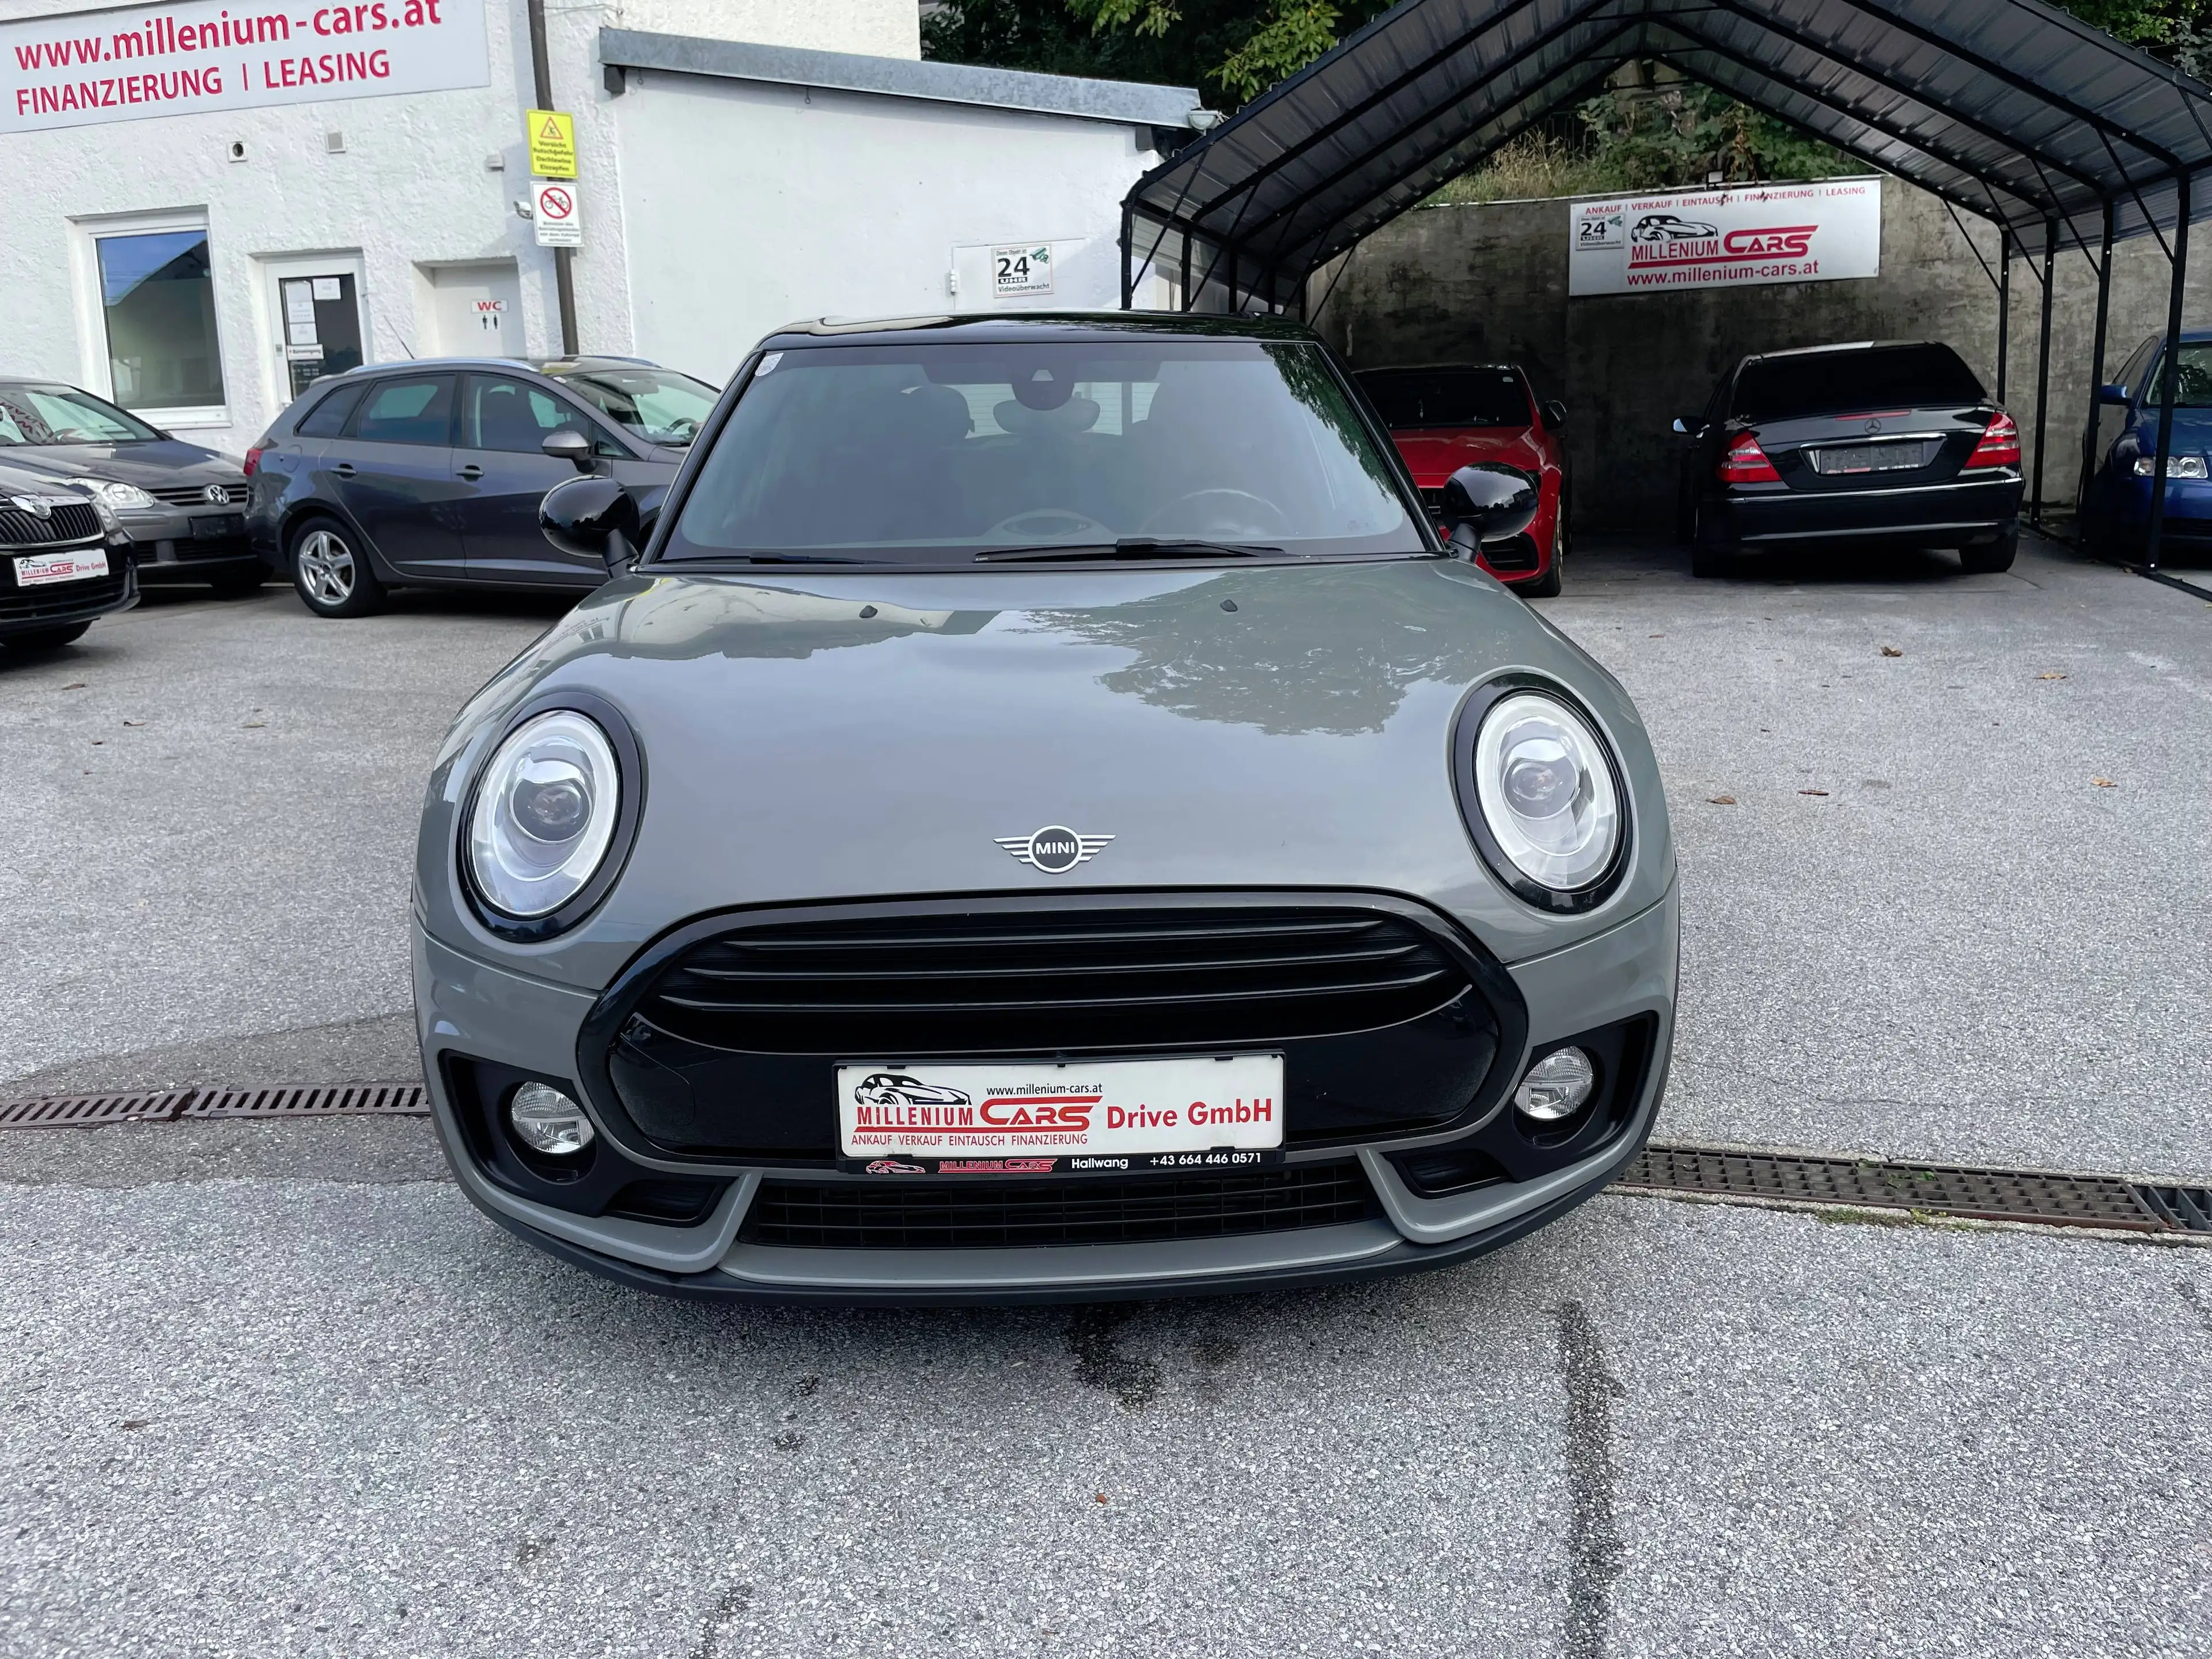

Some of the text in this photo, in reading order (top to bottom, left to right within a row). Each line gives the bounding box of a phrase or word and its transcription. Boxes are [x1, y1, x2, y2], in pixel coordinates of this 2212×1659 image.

[15, 0, 442, 70] www.millenium-cars.at
[16, 67, 223, 116] FINANZIERUNG
[264, 50, 391, 89] LEASING
[1585, 204, 1622, 215] ANKAUF
[1631, 200, 1672, 211] VERKAUF
[1825, 187, 1865, 196] LEASING
[1581, 222, 1607, 236] 24
[1631, 225, 1819, 261] MILLENIUM CARS
[998, 256, 1030, 278] 24
[1627, 260, 1819, 286] www.millenium-cars.at
[478, 301, 502, 311] WC
[50, 562, 74, 573] CARS
[76, 564, 90, 572] Drive
[91, 562, 107, 570] GmbH
[1036, 841, 1075, 854] MINI
[987, 1083, 1103, 1095] www.millenium-cars.at
[857, 1096, 1271, 1131] MILLENIUM CARS Drive GmbH
[851, 1134, 1088, 1146] ANKAUF VERKAUF EINTAUSCH FINANZIERUNG
[940, 1153, 1261, 1173] MILLENIUM CARS Hallwang +43 664 446 0571
